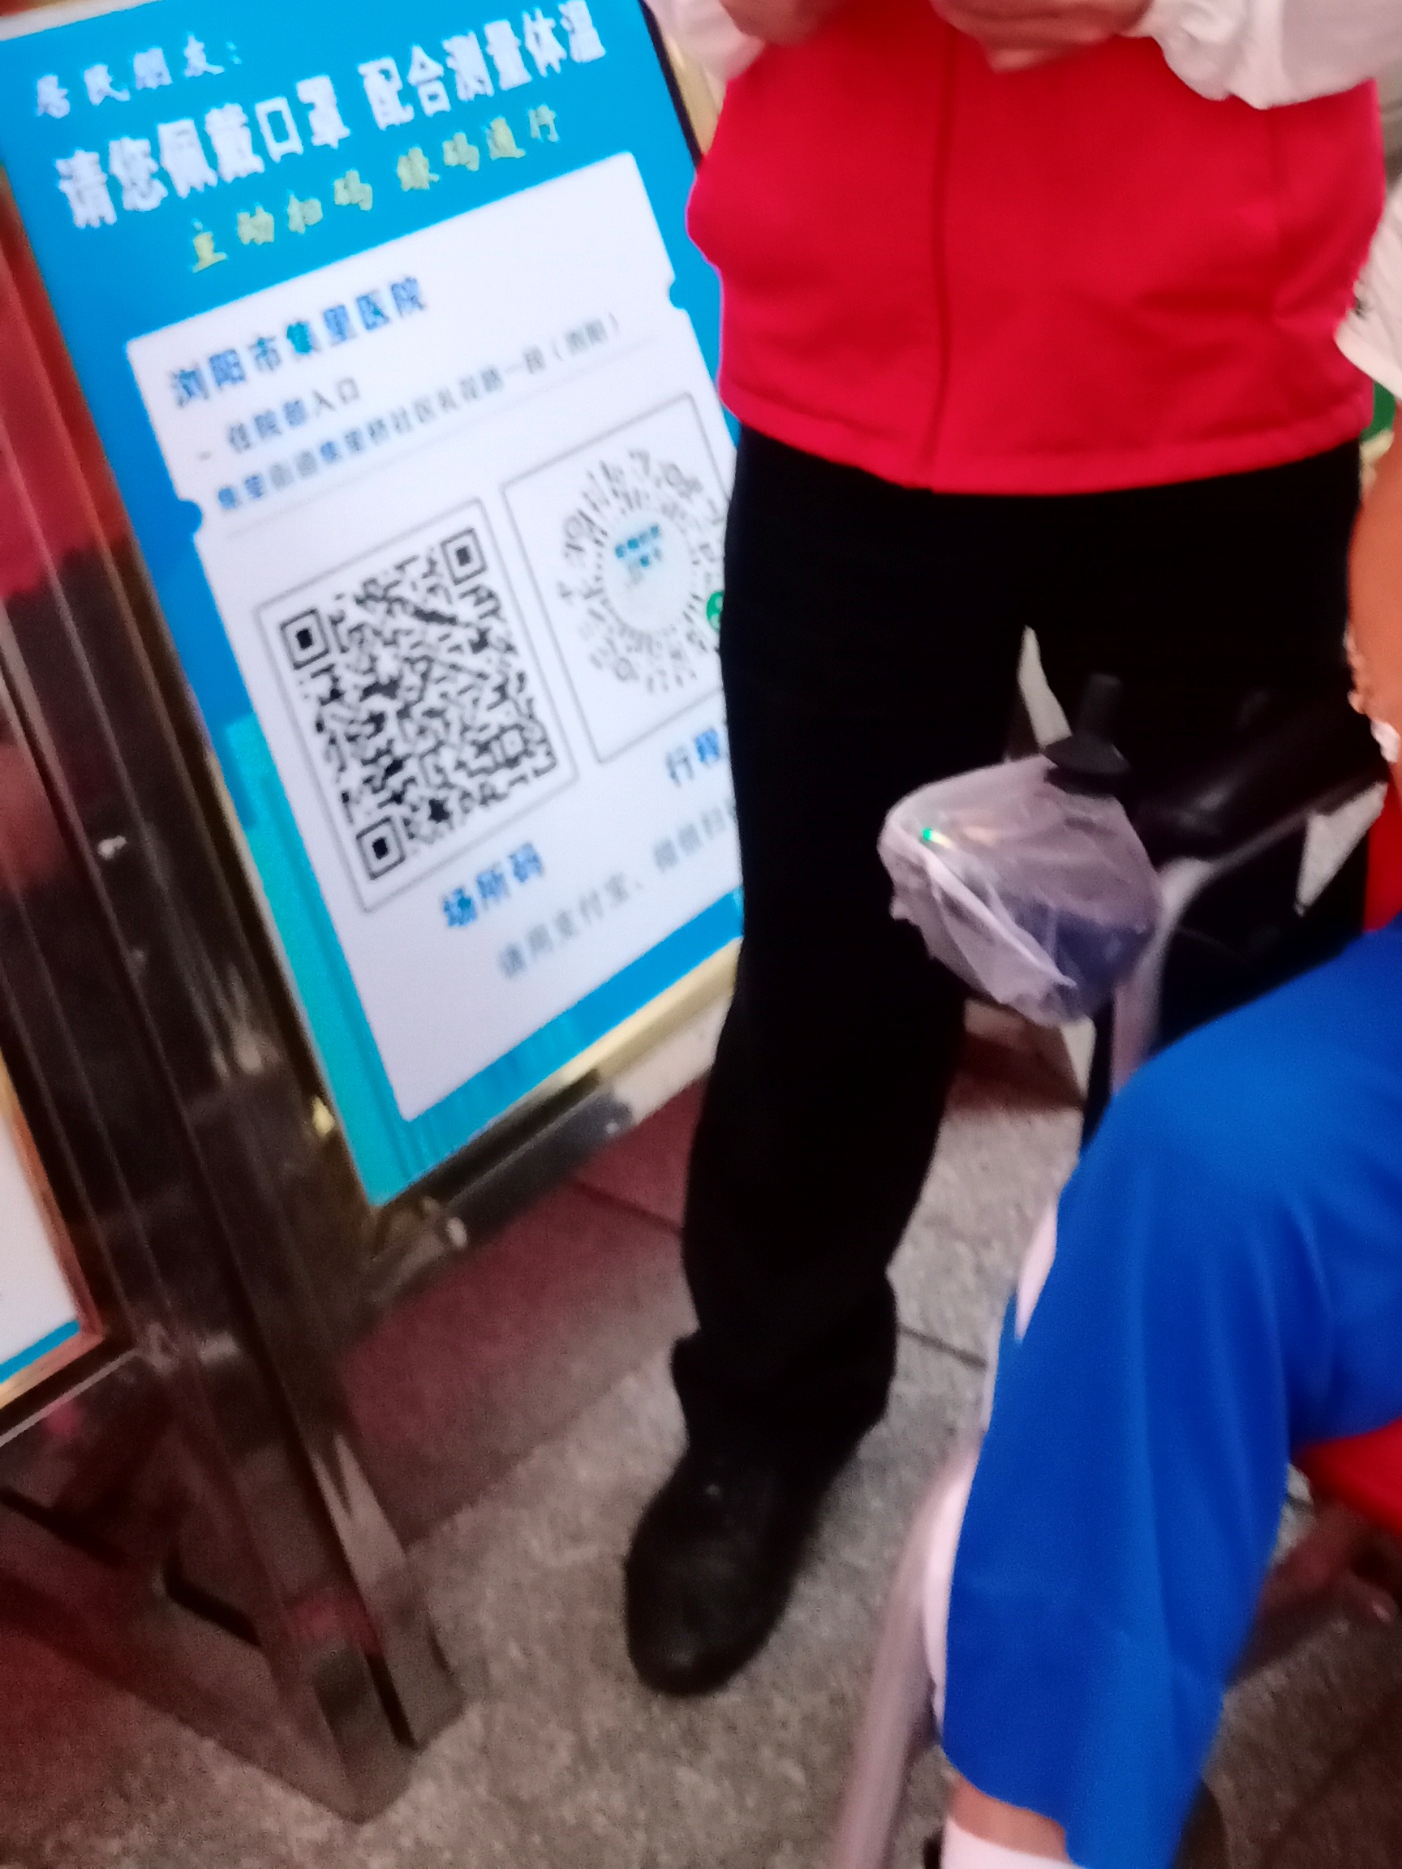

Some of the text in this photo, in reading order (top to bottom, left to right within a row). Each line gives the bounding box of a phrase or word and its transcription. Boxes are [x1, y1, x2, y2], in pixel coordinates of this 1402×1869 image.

[54, 73, 352, 230] 请您佩戴口罩
[169, 273, 426, 409] 浏阳市集里医院
[226, 375, 361, 455] 住院部入口
[664, 725, 727, 788] 行程
[440, 839, 545, 929] 场所码
